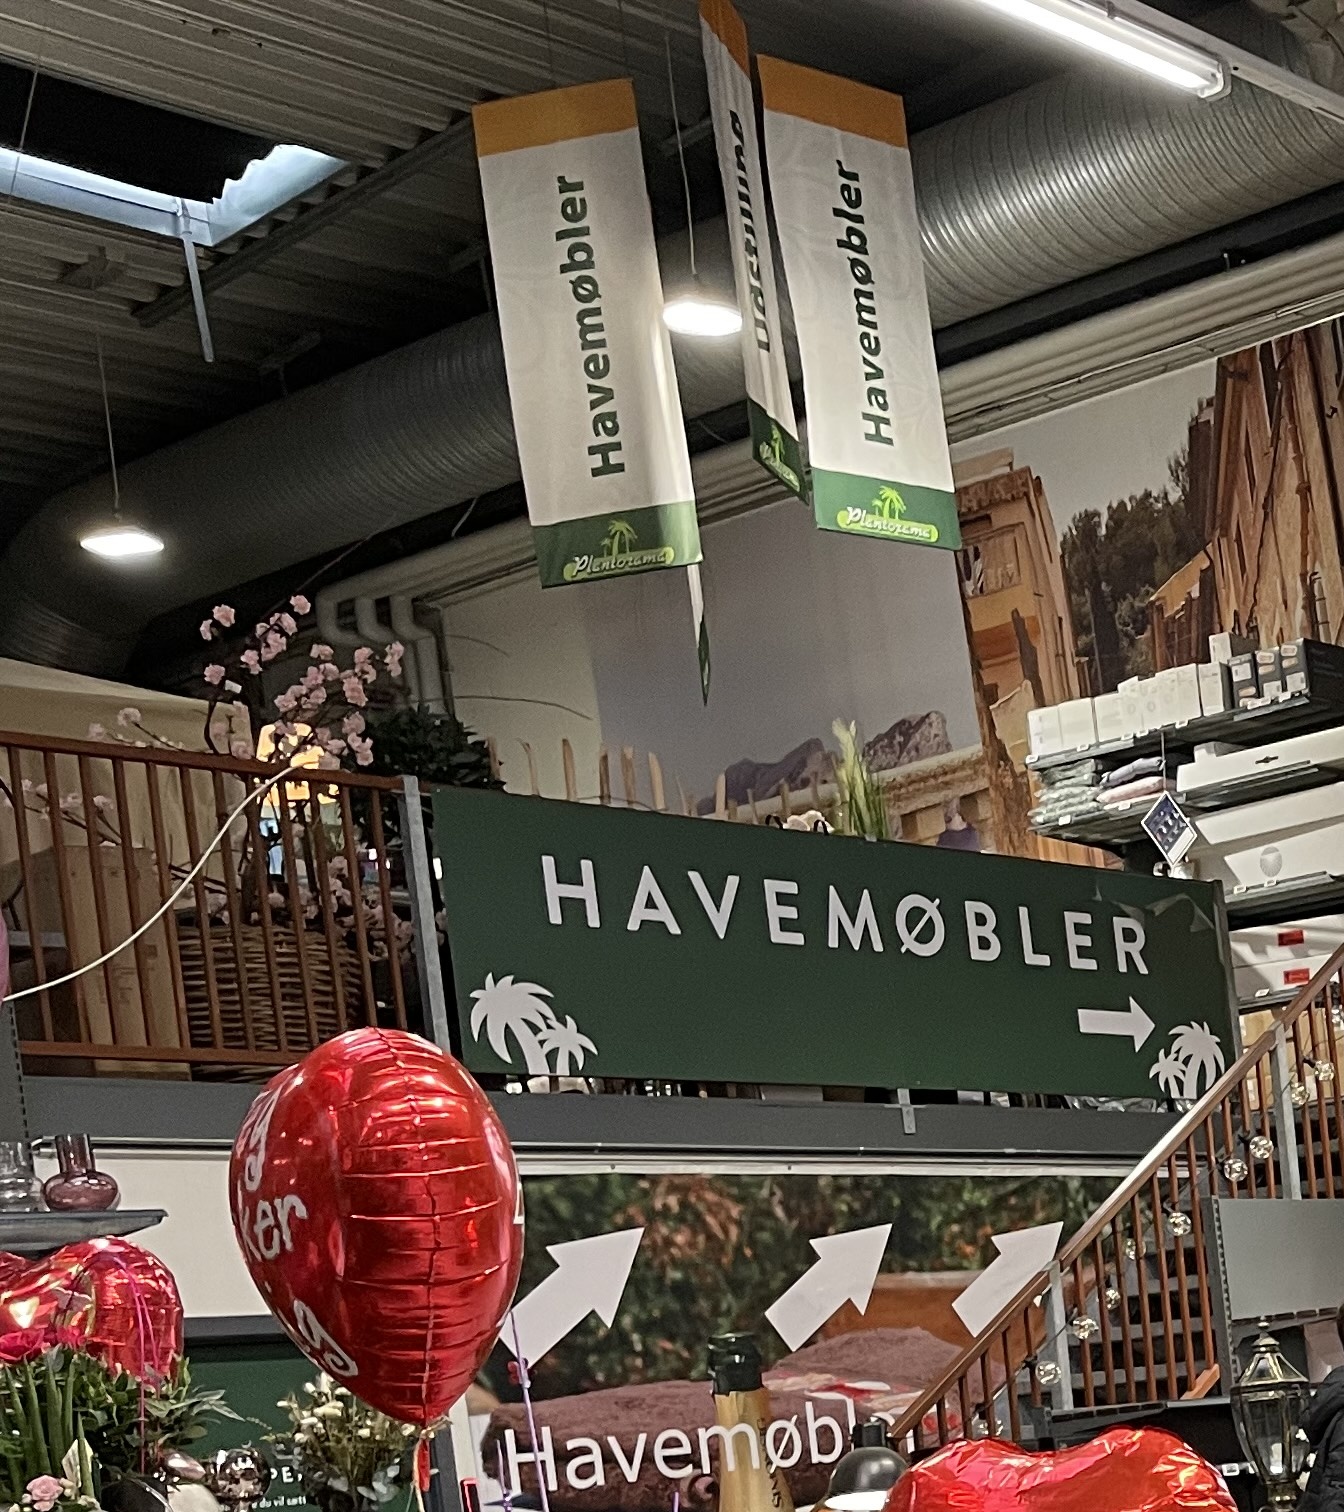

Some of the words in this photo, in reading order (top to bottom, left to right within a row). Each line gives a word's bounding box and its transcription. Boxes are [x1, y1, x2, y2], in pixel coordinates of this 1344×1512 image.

[558, 176, 626, 479] Havemøbler
[832, 160, 896, 447] Havemøbler
[570, 549, 668, 577] Plantorama
[846, 507, 932, 538] Plantorama
[541, 854, 1149, 975] HAVEMØBLER
[504, 1397, 893, 1494] Havemøbl
